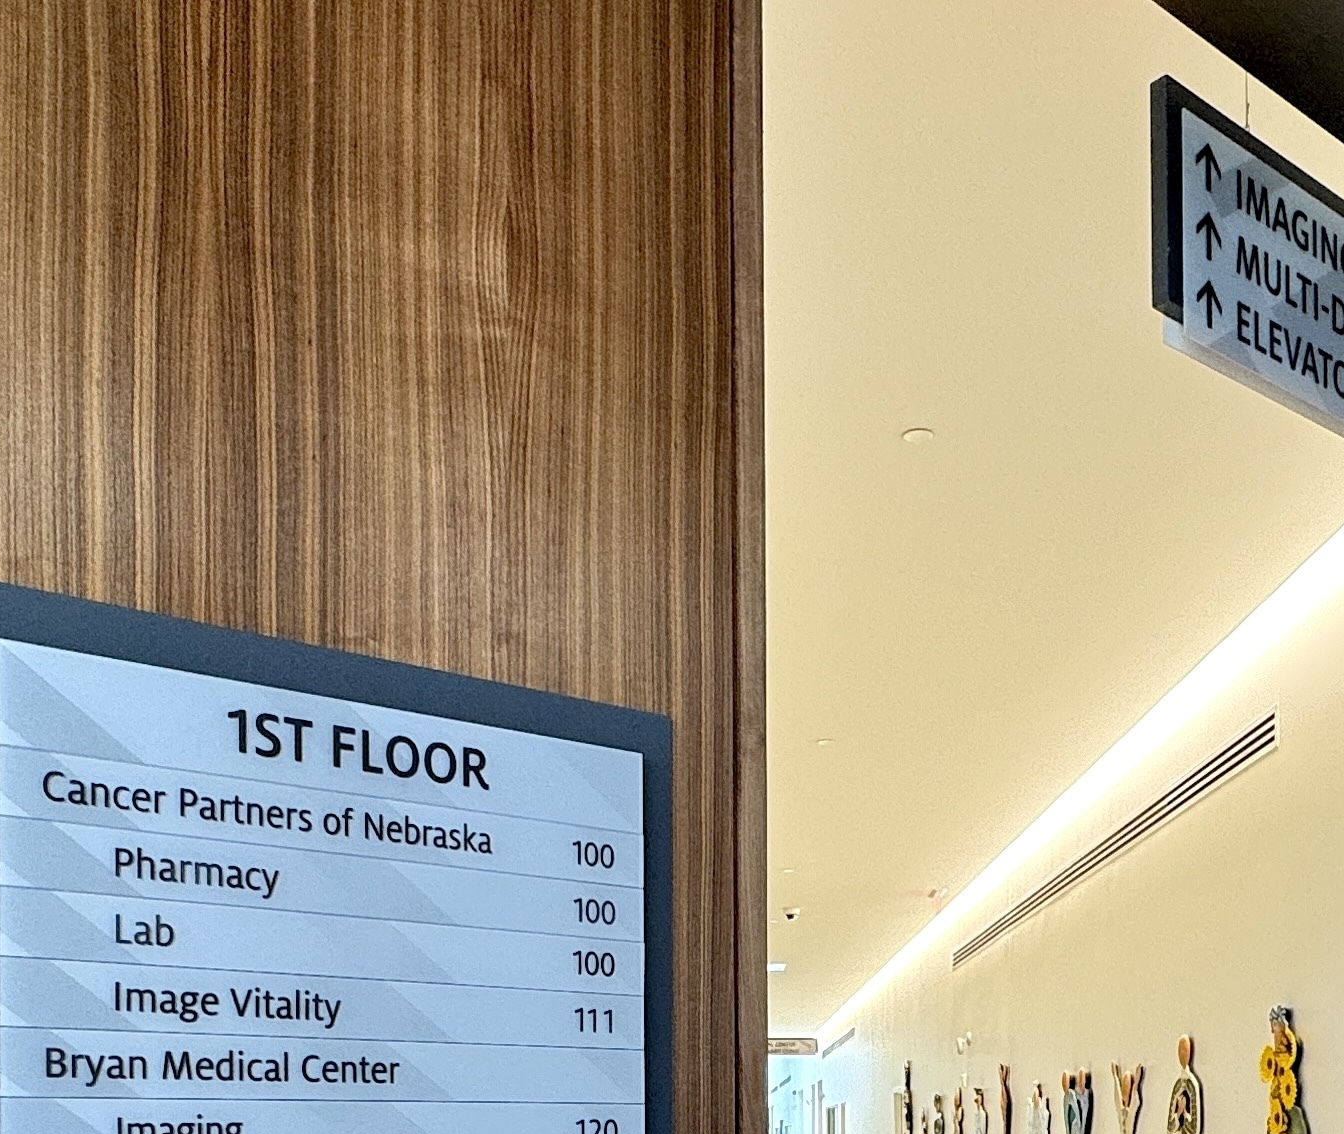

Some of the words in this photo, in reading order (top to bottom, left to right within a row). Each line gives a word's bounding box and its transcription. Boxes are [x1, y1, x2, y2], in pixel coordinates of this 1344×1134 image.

[227, 709, 314, 763] 1ST
[332, 725, 490, 791] FLOOR
[42, 770, 167, 814] Cancer
[179, 787, 313, 833] Partners
[323, 807, 354, 837] of
[364, 811, 493, 855] Nebraska
[572, 840, 615, 869] 100
[114, 847, 280, 900] Pharmacy
[573, 897, 616, 926] 100
[115, 913, 175, 947] Lab
[572, 950, 616, 978] 100
[114, 981, 220, 1023] Image
[229, 988, 342, 1030] Vitality
[574, 1007, 613, 1034] 111
[45, 1047, 147, 1088] Bryan
[162, 1049, 289, 1083] Medical
[301, 1054, 400, 1084] Center
